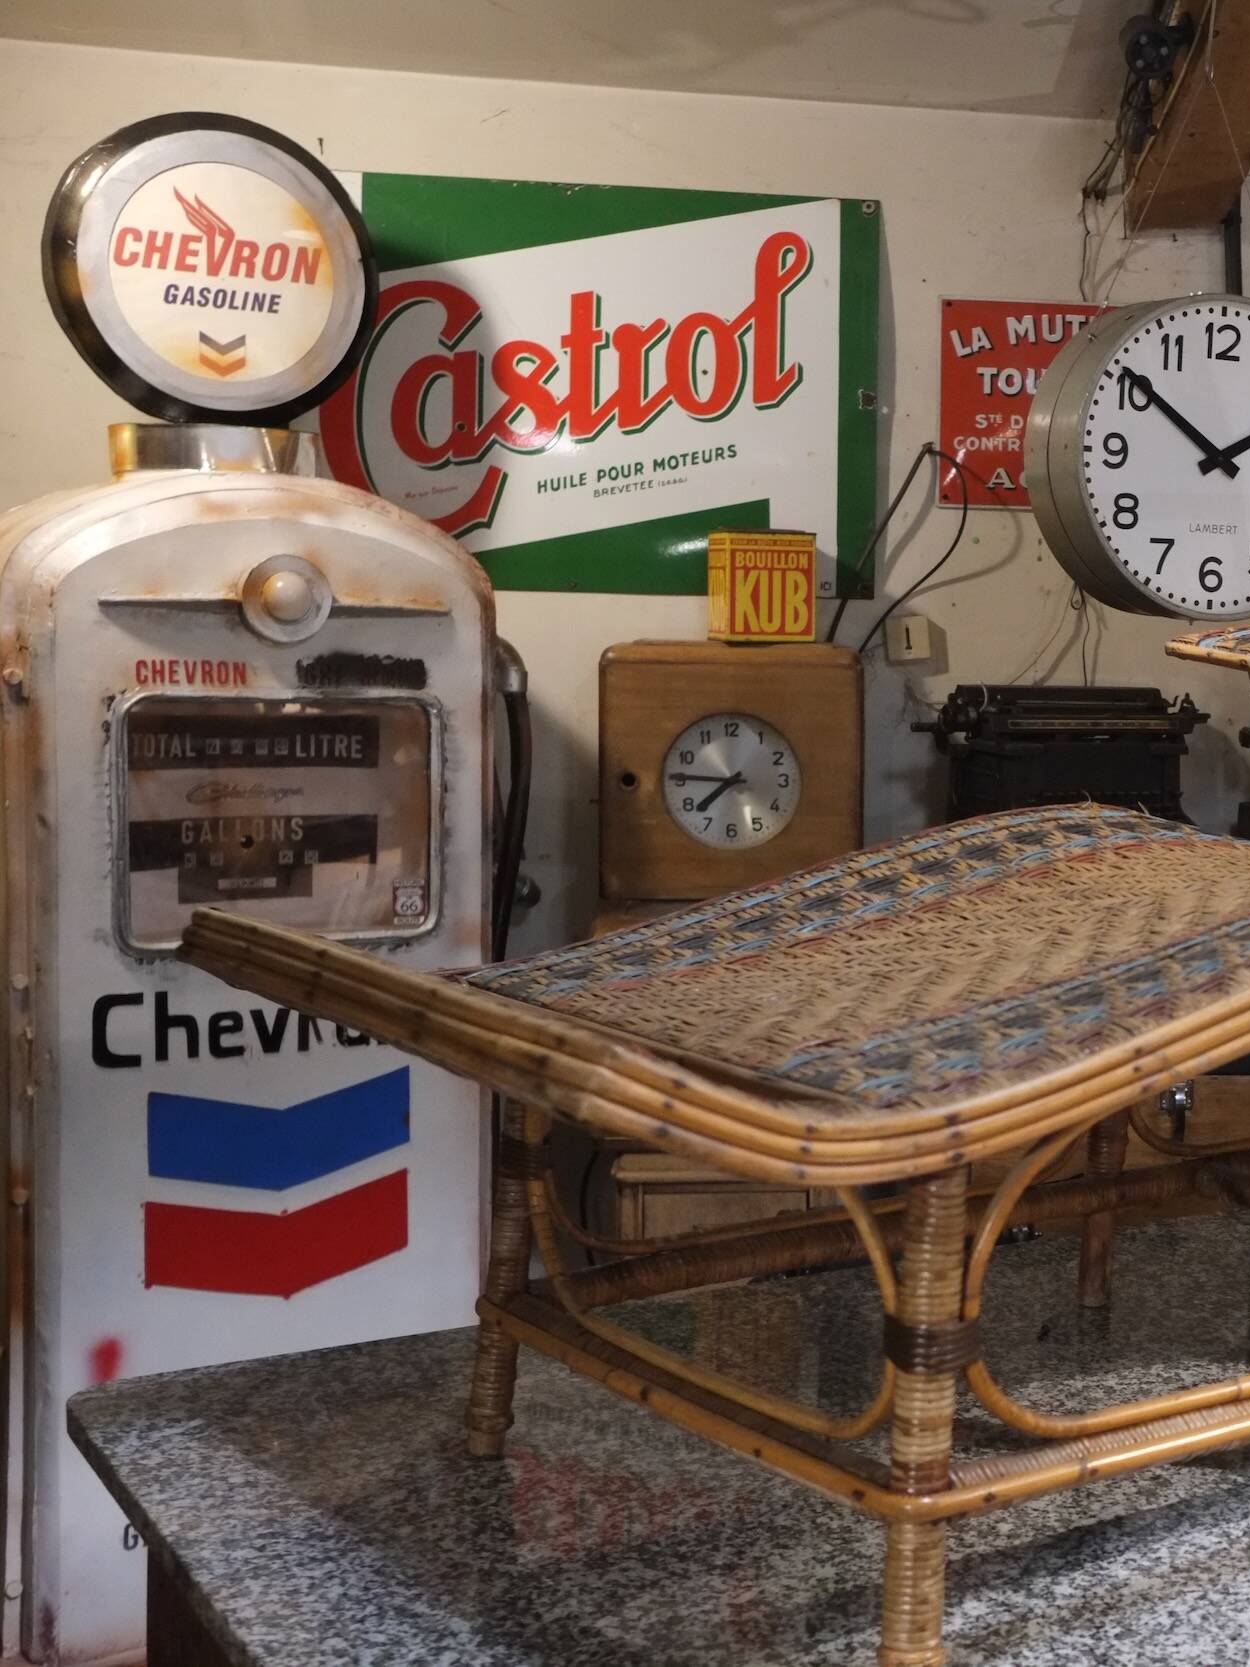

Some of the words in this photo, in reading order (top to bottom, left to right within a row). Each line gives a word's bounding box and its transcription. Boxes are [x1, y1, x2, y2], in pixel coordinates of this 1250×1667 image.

[113, 222, 323, 286] CHEVRON
[162, 283, 282, 314] GASOLINE
[950, 326, 992, 357] LA
[1006, 314, 1096, 345] MUT
[1205, 324, 1241, 362] 12
[1161, 334, 1184, 372] 11
[319, 231, 814, 539] Castrol
[1117, 370, 1154, 412] 10
[1102, 432, 1128, 469] 9
[537, 472, 588, 494] HUILE
[597, 461, 645, 483] POUR
[652, 444, 738, 473] MOTEURS
[1112, 493, 1139, 530] 8
[1189, 523, 1238, 535] LAMBERT
[735, 551, 809, 569] BOUILLON
[1149, 538, 1175, 575] 7
[1199, 556, 1223, 592] 6
[735, 569, 809, 633] KUB
[135, 658, 248, 686] CHEVRON
[699, 731, 711, 745] 11
[723, 722, 739, 737] 12
[758, 731, 764, 745] 1
[131, 733, 196, 759] TOTAL
[295, 734, 363, 759] LITRE
[679, 751, 695, 766] 10
[772, 752, 785, 766] 2
[778, 774, 789, 789] 3
[682, 798, 695, 813] 8
[769, 799, 780, 813] 4
[181, 817, 304, 845] GALLONS
[702, 818, 713, 832] 7
[726, 824, 738, 838] 6
[751, 818, 763, 832] 5
[400, 900, 418, 913] 66
[92, 991, 388, 1069] Chevr
